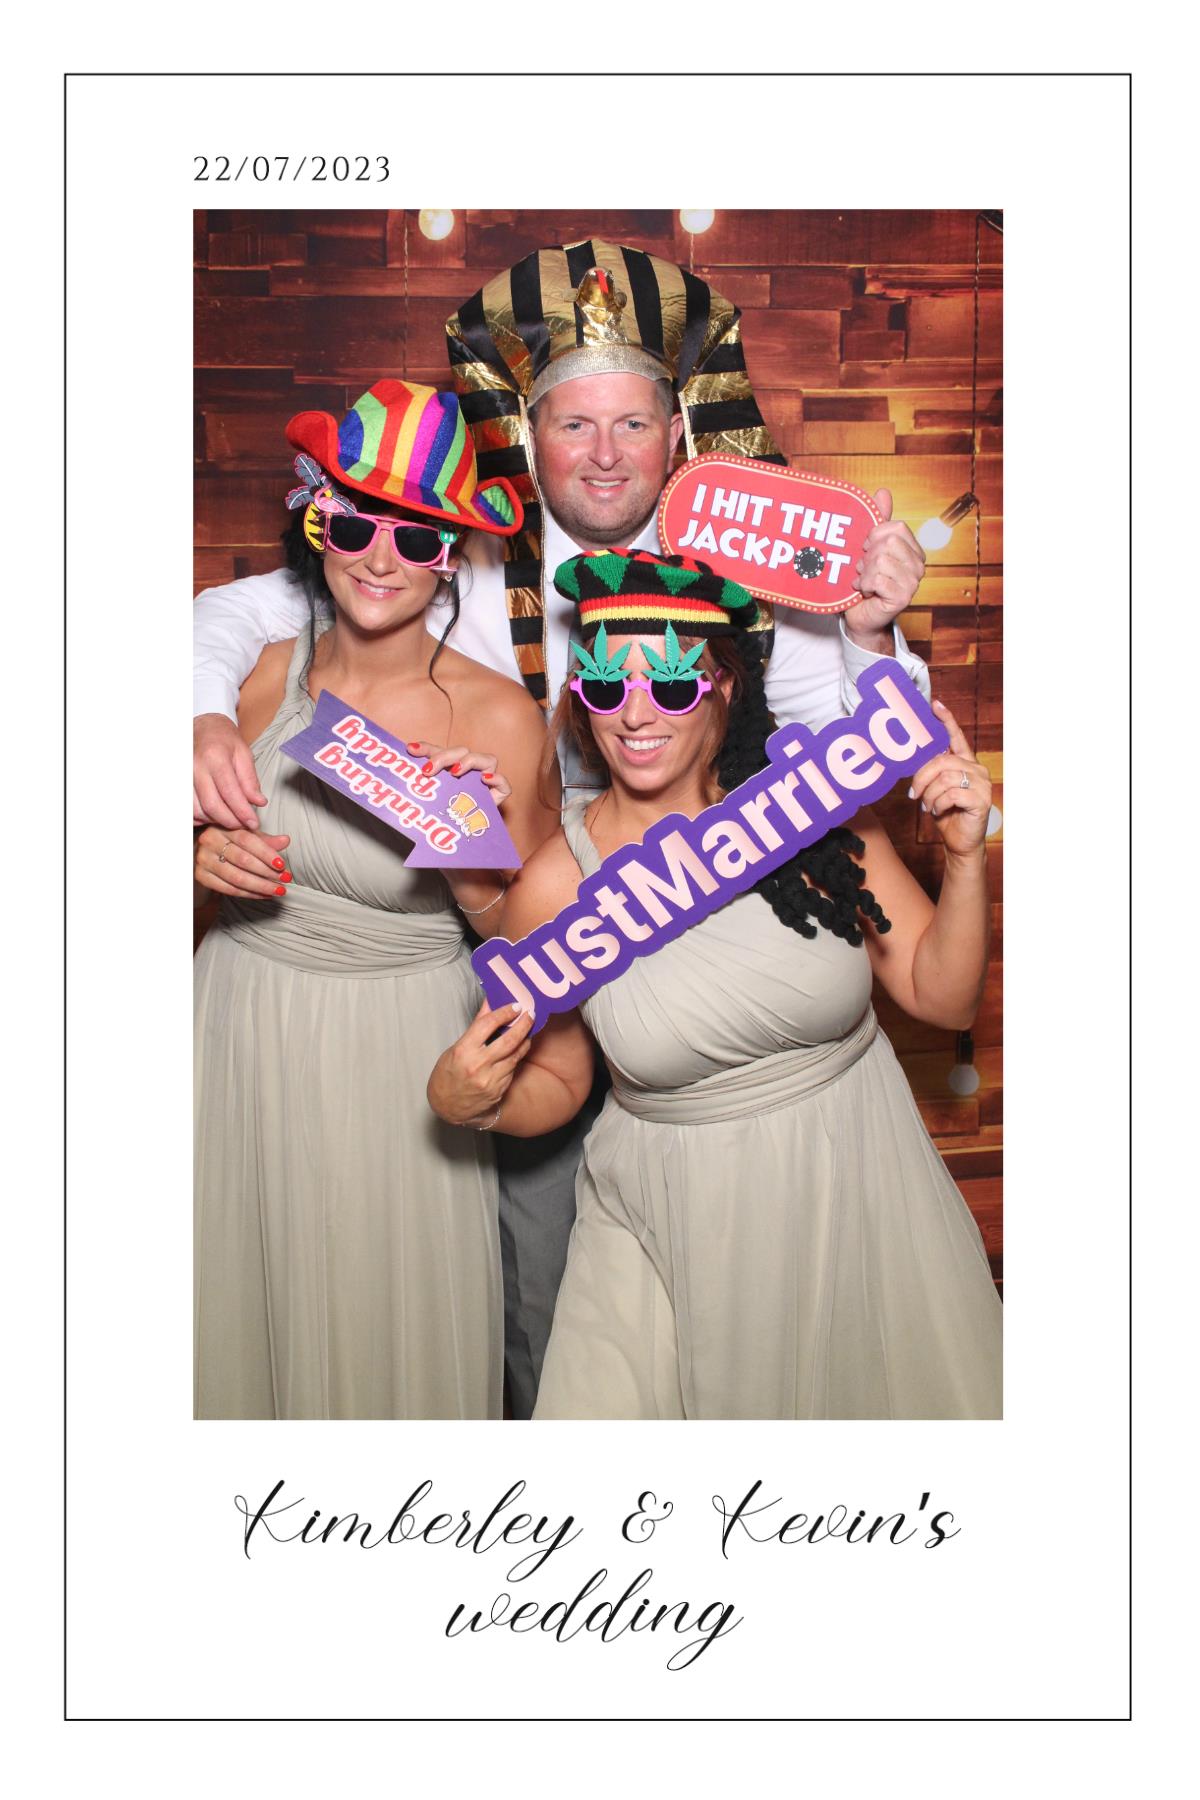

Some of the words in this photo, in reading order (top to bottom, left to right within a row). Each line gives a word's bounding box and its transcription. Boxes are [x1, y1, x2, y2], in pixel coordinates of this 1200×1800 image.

[678, 519, 851, 584] JACKPOT
[691, 483, 707, 513] I
[710, 487, 774, 527] HIT
[780, 502, 853, 548] THE
[333, 716, 440, 800] Buddy
[316, 743, 460, 852] Drinking
